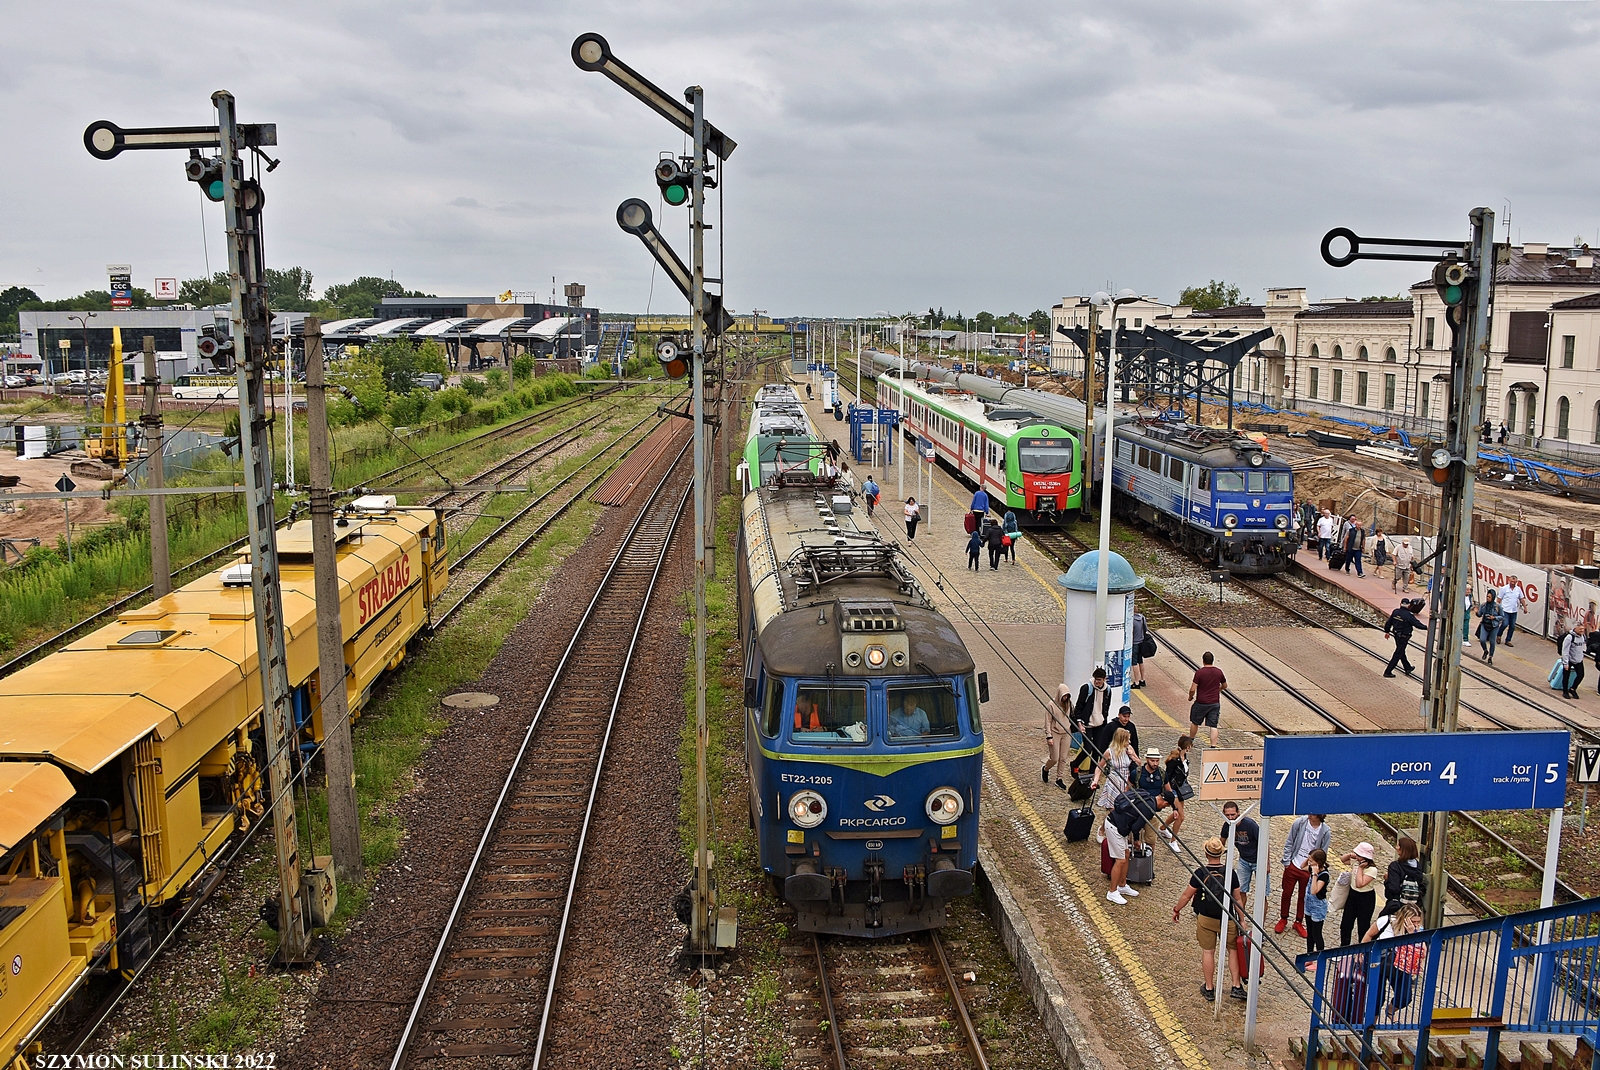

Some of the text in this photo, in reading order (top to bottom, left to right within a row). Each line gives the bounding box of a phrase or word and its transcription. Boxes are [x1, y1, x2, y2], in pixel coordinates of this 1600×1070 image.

[359, 553, 410, 625] STRABAG
[1302, 768, 1322, 780] tor
[1390, 761, 1458, 785] peron 4
[1512, 764, 1532, 775] tor
[1544, 763, 1559, 784] 5
[781, 773, 833, 785] ET22-1205
[1275, 769, 1290, 790] 7
[1377, 779, 1403, 787] platform
[839, 816, 907, 827] PKPCARGO
